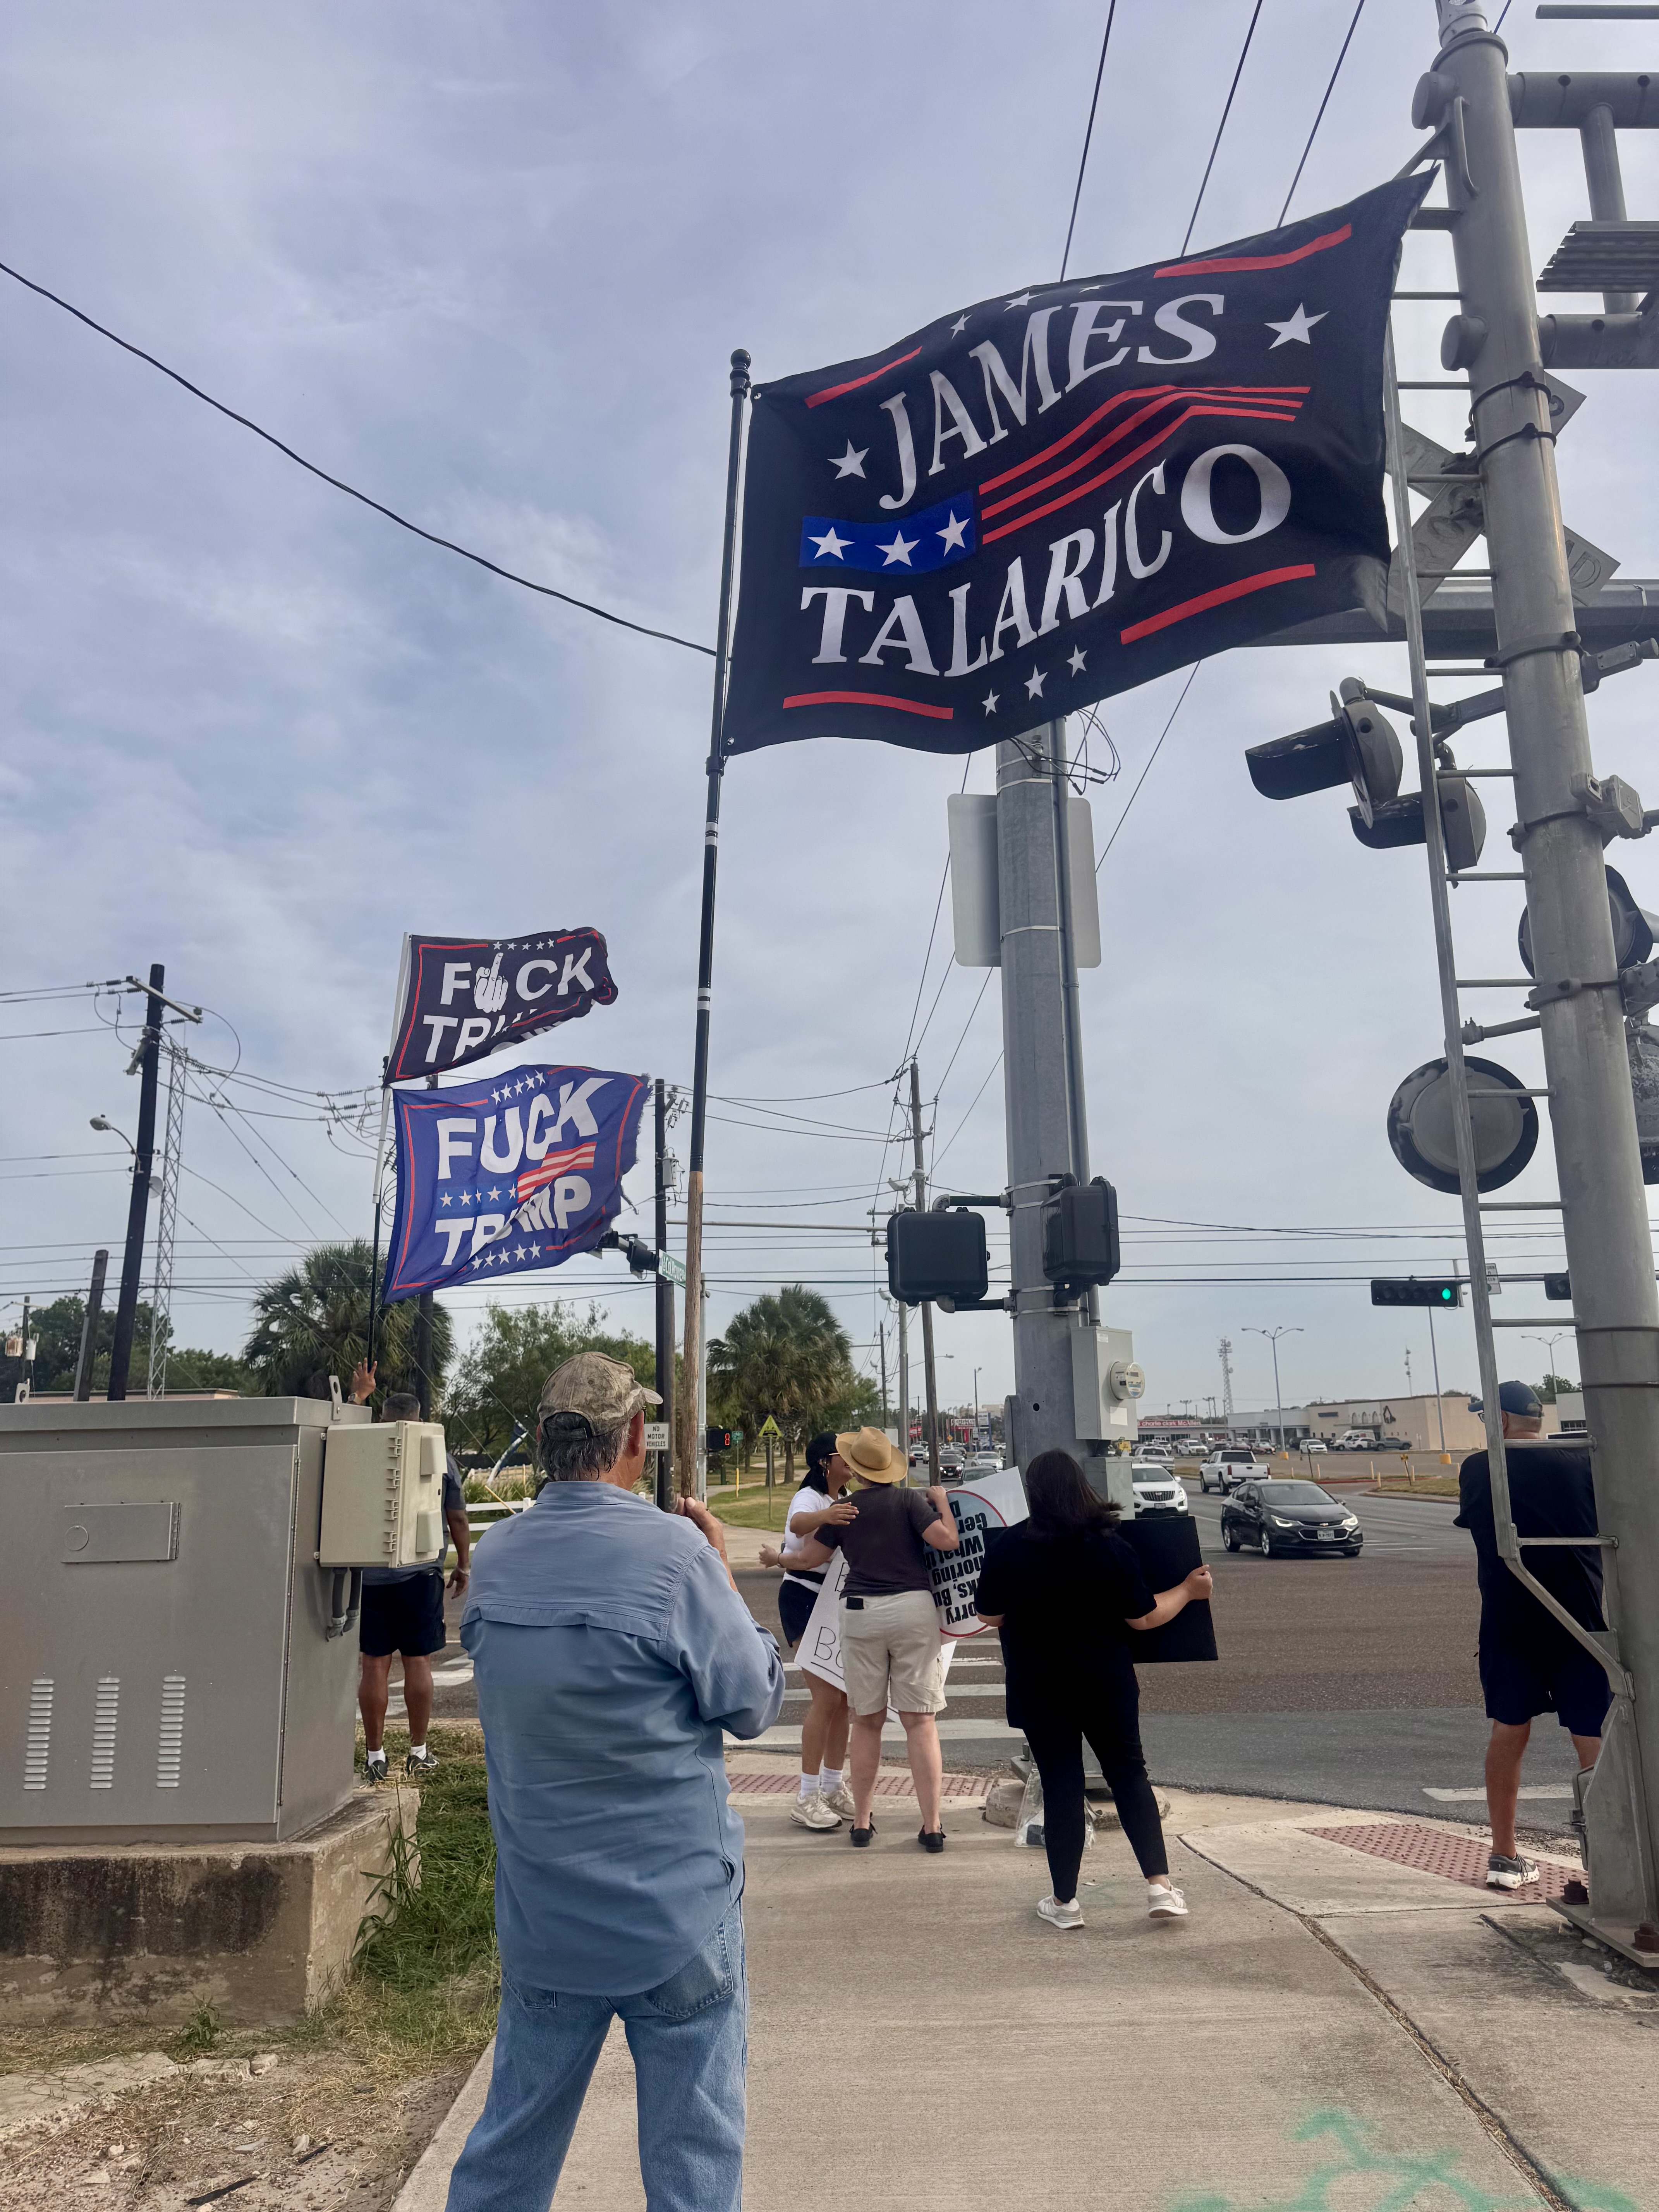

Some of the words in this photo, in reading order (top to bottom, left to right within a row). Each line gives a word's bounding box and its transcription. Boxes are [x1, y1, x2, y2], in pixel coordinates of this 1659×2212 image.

[879, 293, 1225, 510] JAMES
[800, 443, 1291, 677] TALARICO
[440, 947, 594, 1007] FCK
[437, 1077, 615, 1180] FUCK
[932, 1555, 984, 1586] noring
[933, 1588, 952, 1607] Bu
[946, 1602, 977, 1625] orry
